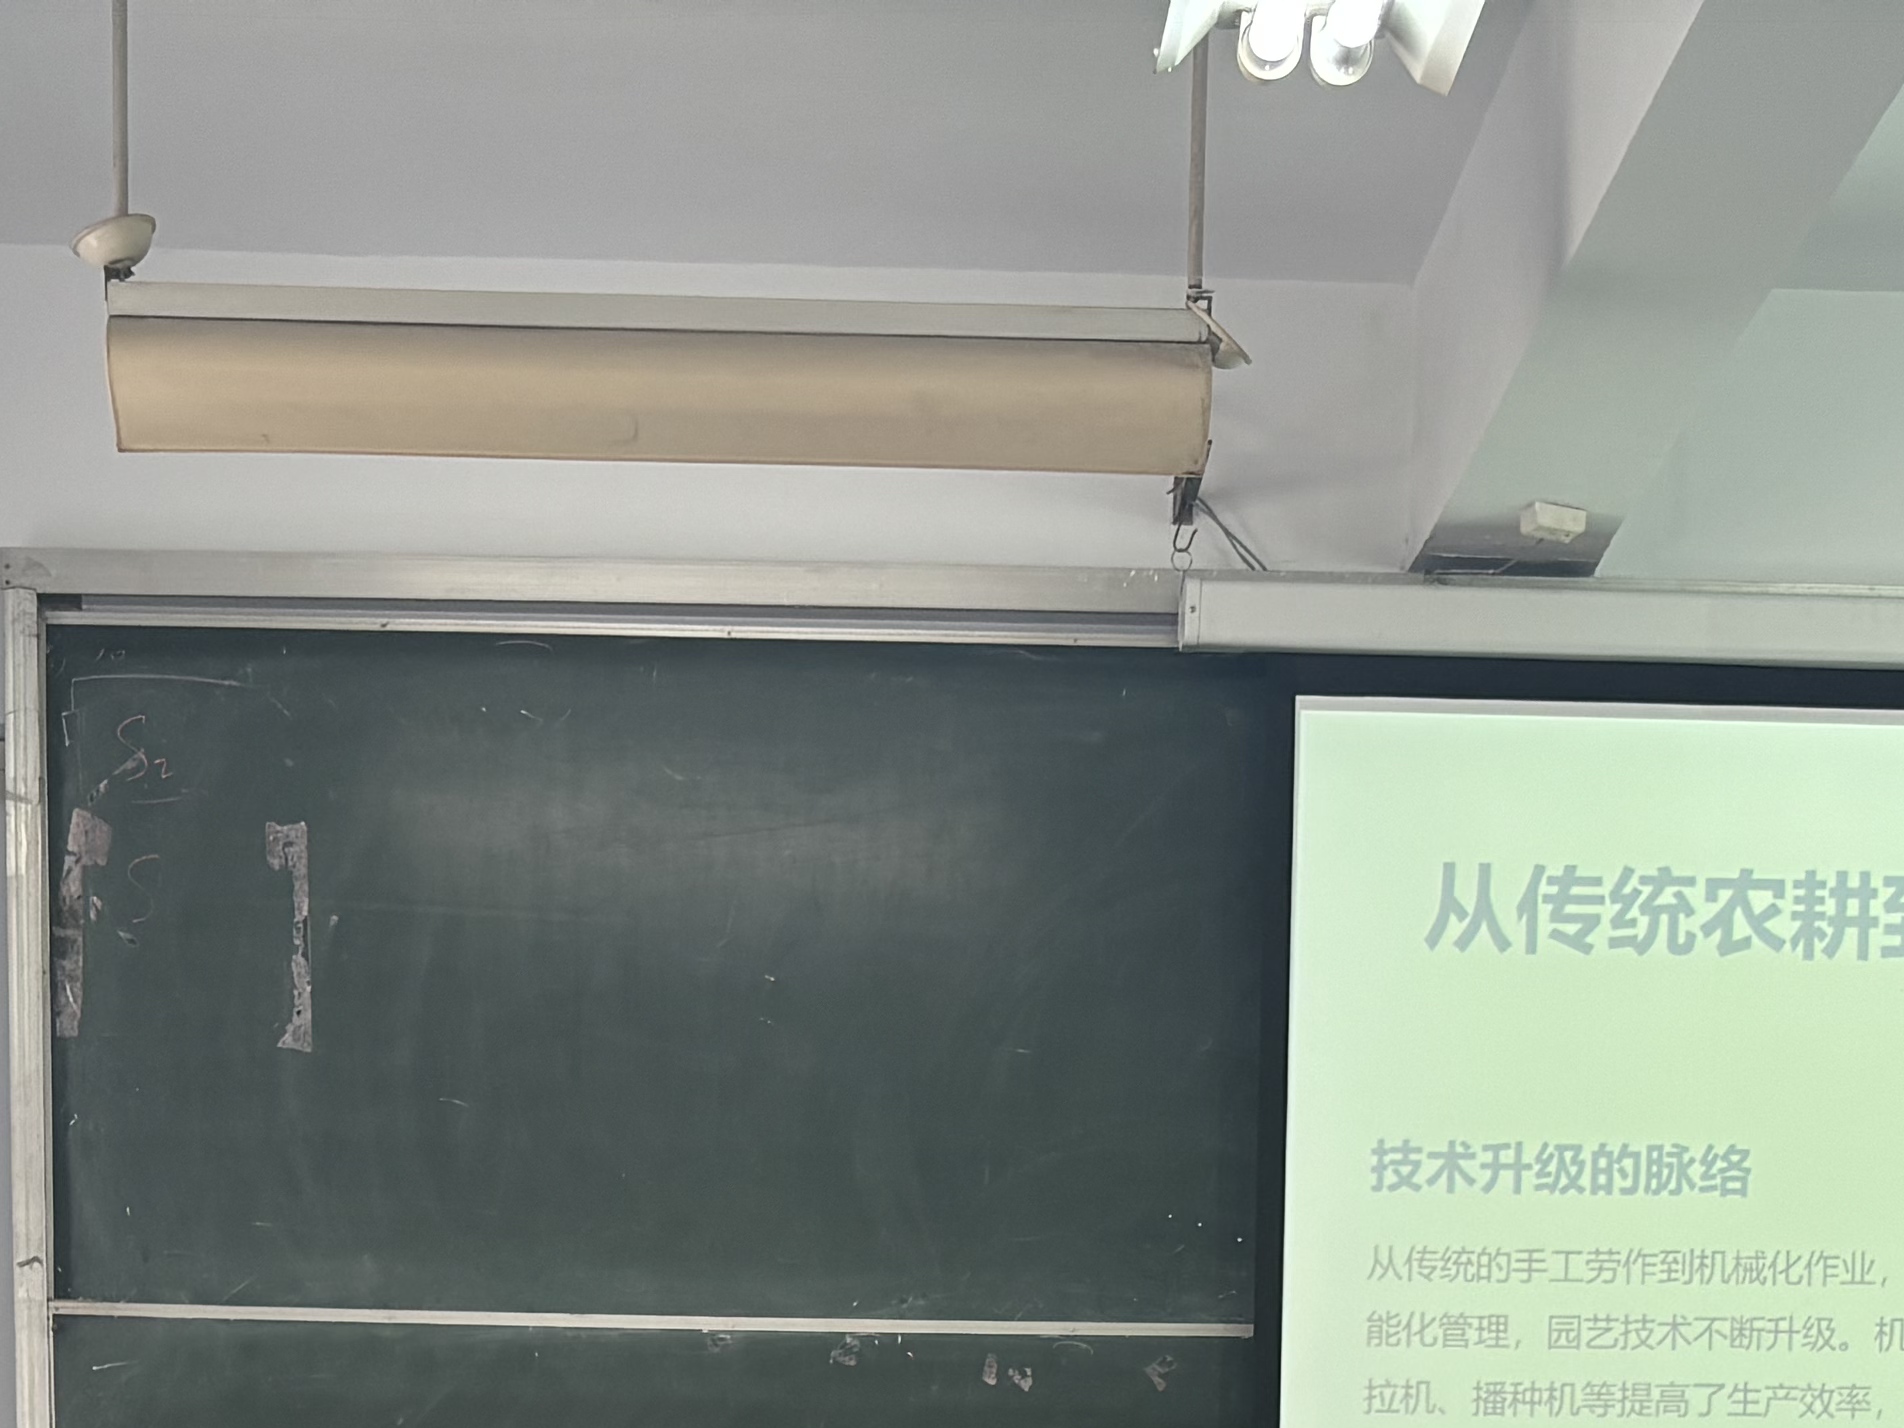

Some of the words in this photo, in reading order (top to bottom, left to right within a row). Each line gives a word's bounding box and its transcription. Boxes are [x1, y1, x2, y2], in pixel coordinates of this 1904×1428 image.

[1369, 1137, 1754, 1200] 技术升级的脉络
